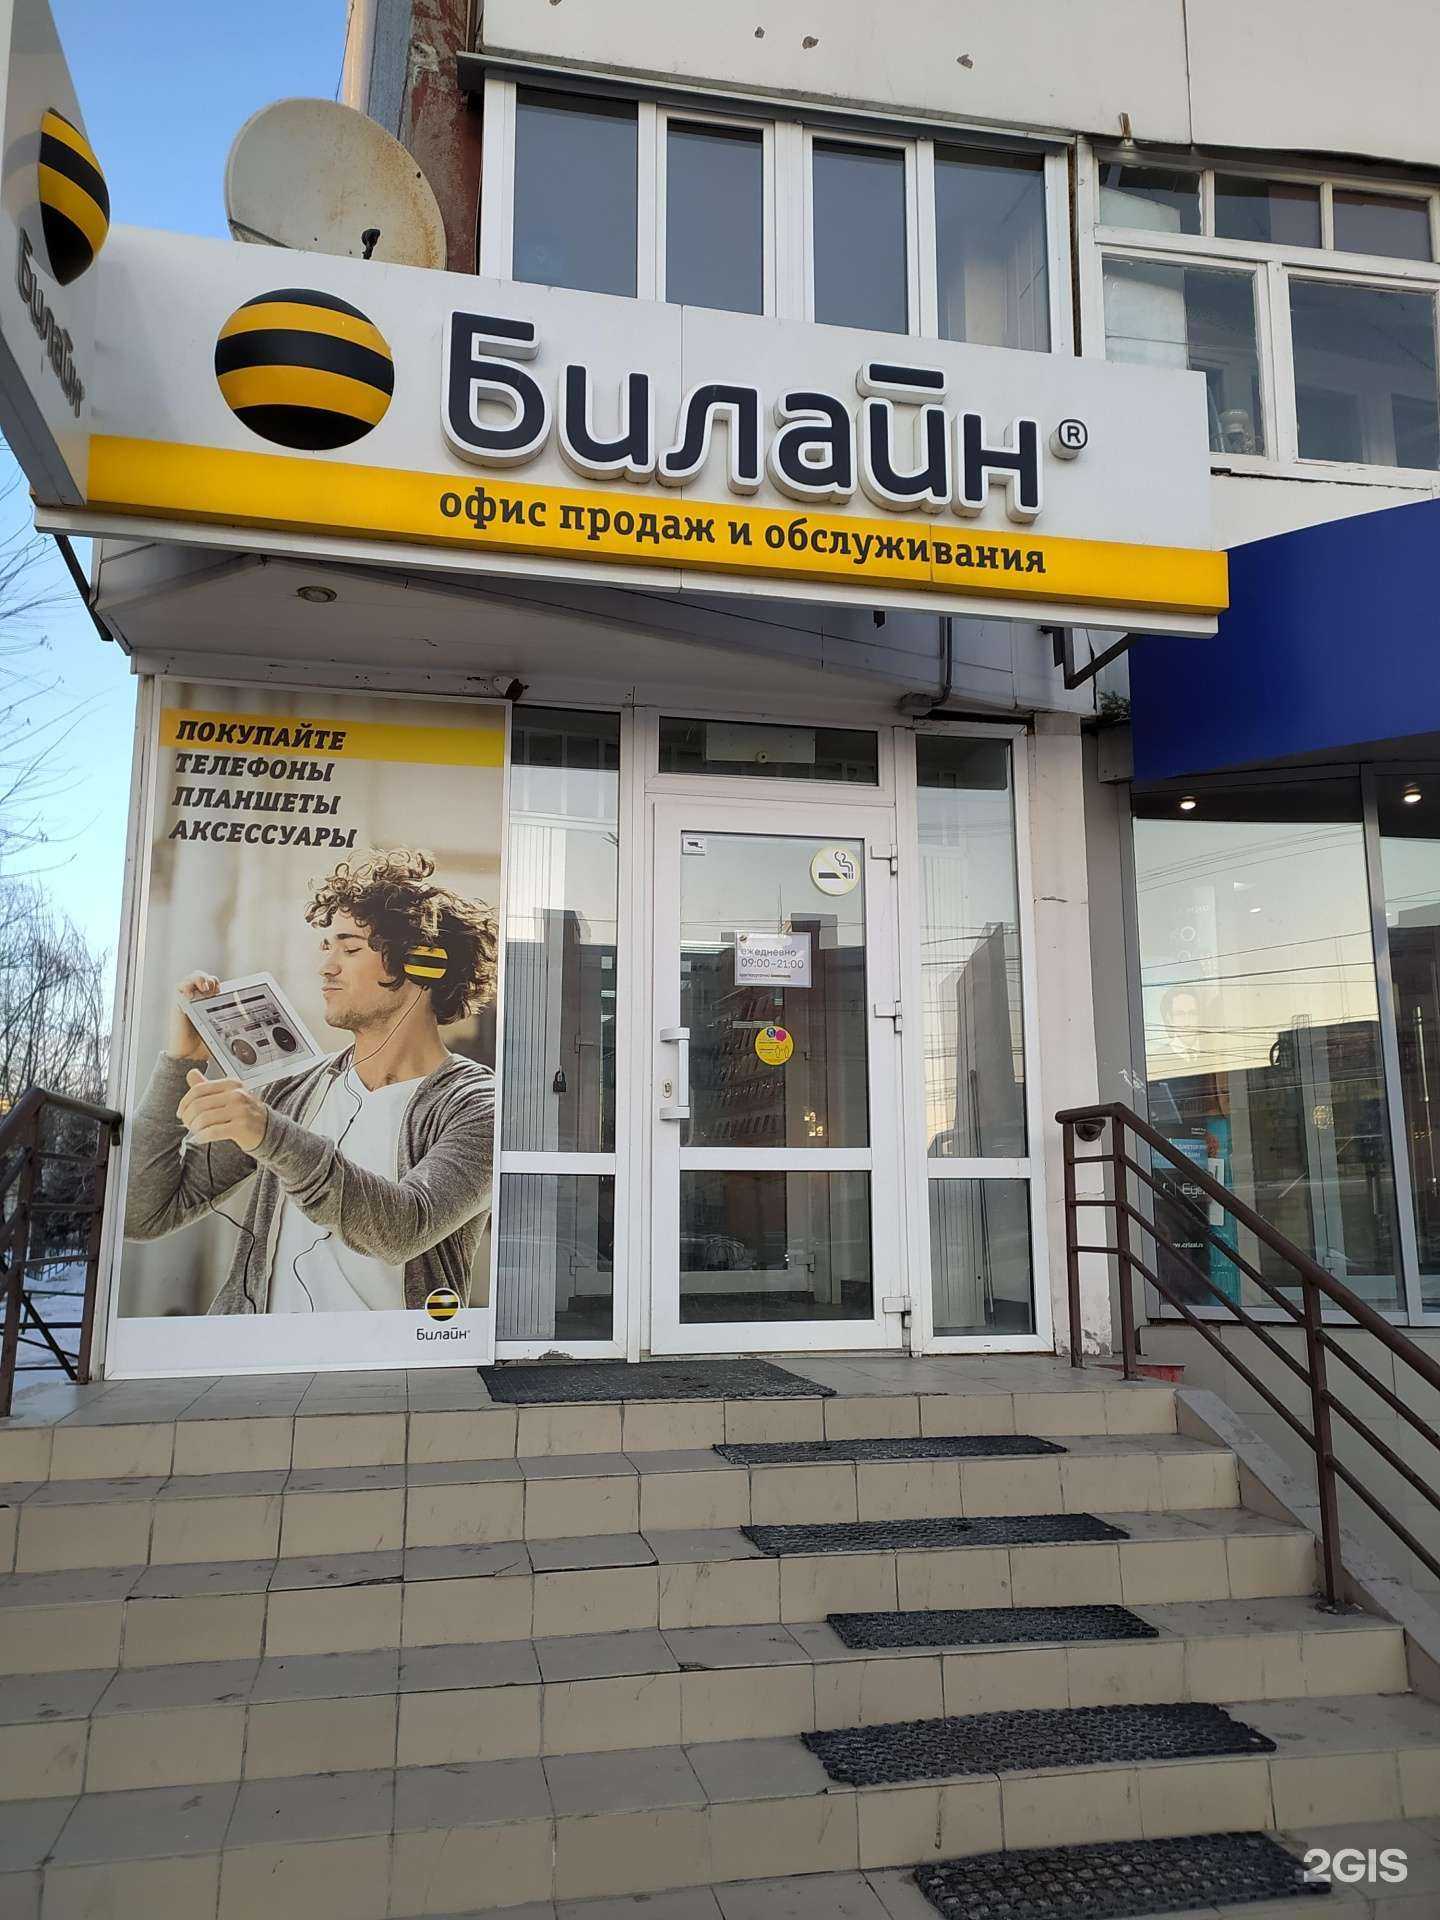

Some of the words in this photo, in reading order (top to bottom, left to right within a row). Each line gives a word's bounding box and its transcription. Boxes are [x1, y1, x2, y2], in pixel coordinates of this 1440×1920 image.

[447, 310, 1041, 512] Билайн
[439, 487, 547, 530] офис
[559, 504, 716, 545] продаж
[727, 520, 753, 547] и
[765, 517, 1047, 574] обслуживания
[175, 720, 347, 751] ПОКУПАЙТЕ
[174, 752, 336, 782] ТЕЛЕФОНЫ
[171, 785, 342, 816] ПЛАНШЕТЫ
[168, 819, 358, 849] АКСЕССУАРЫ
[741, 947, 797, 958] ежедневно
[416, 1327, 467, 1341] Билайн
